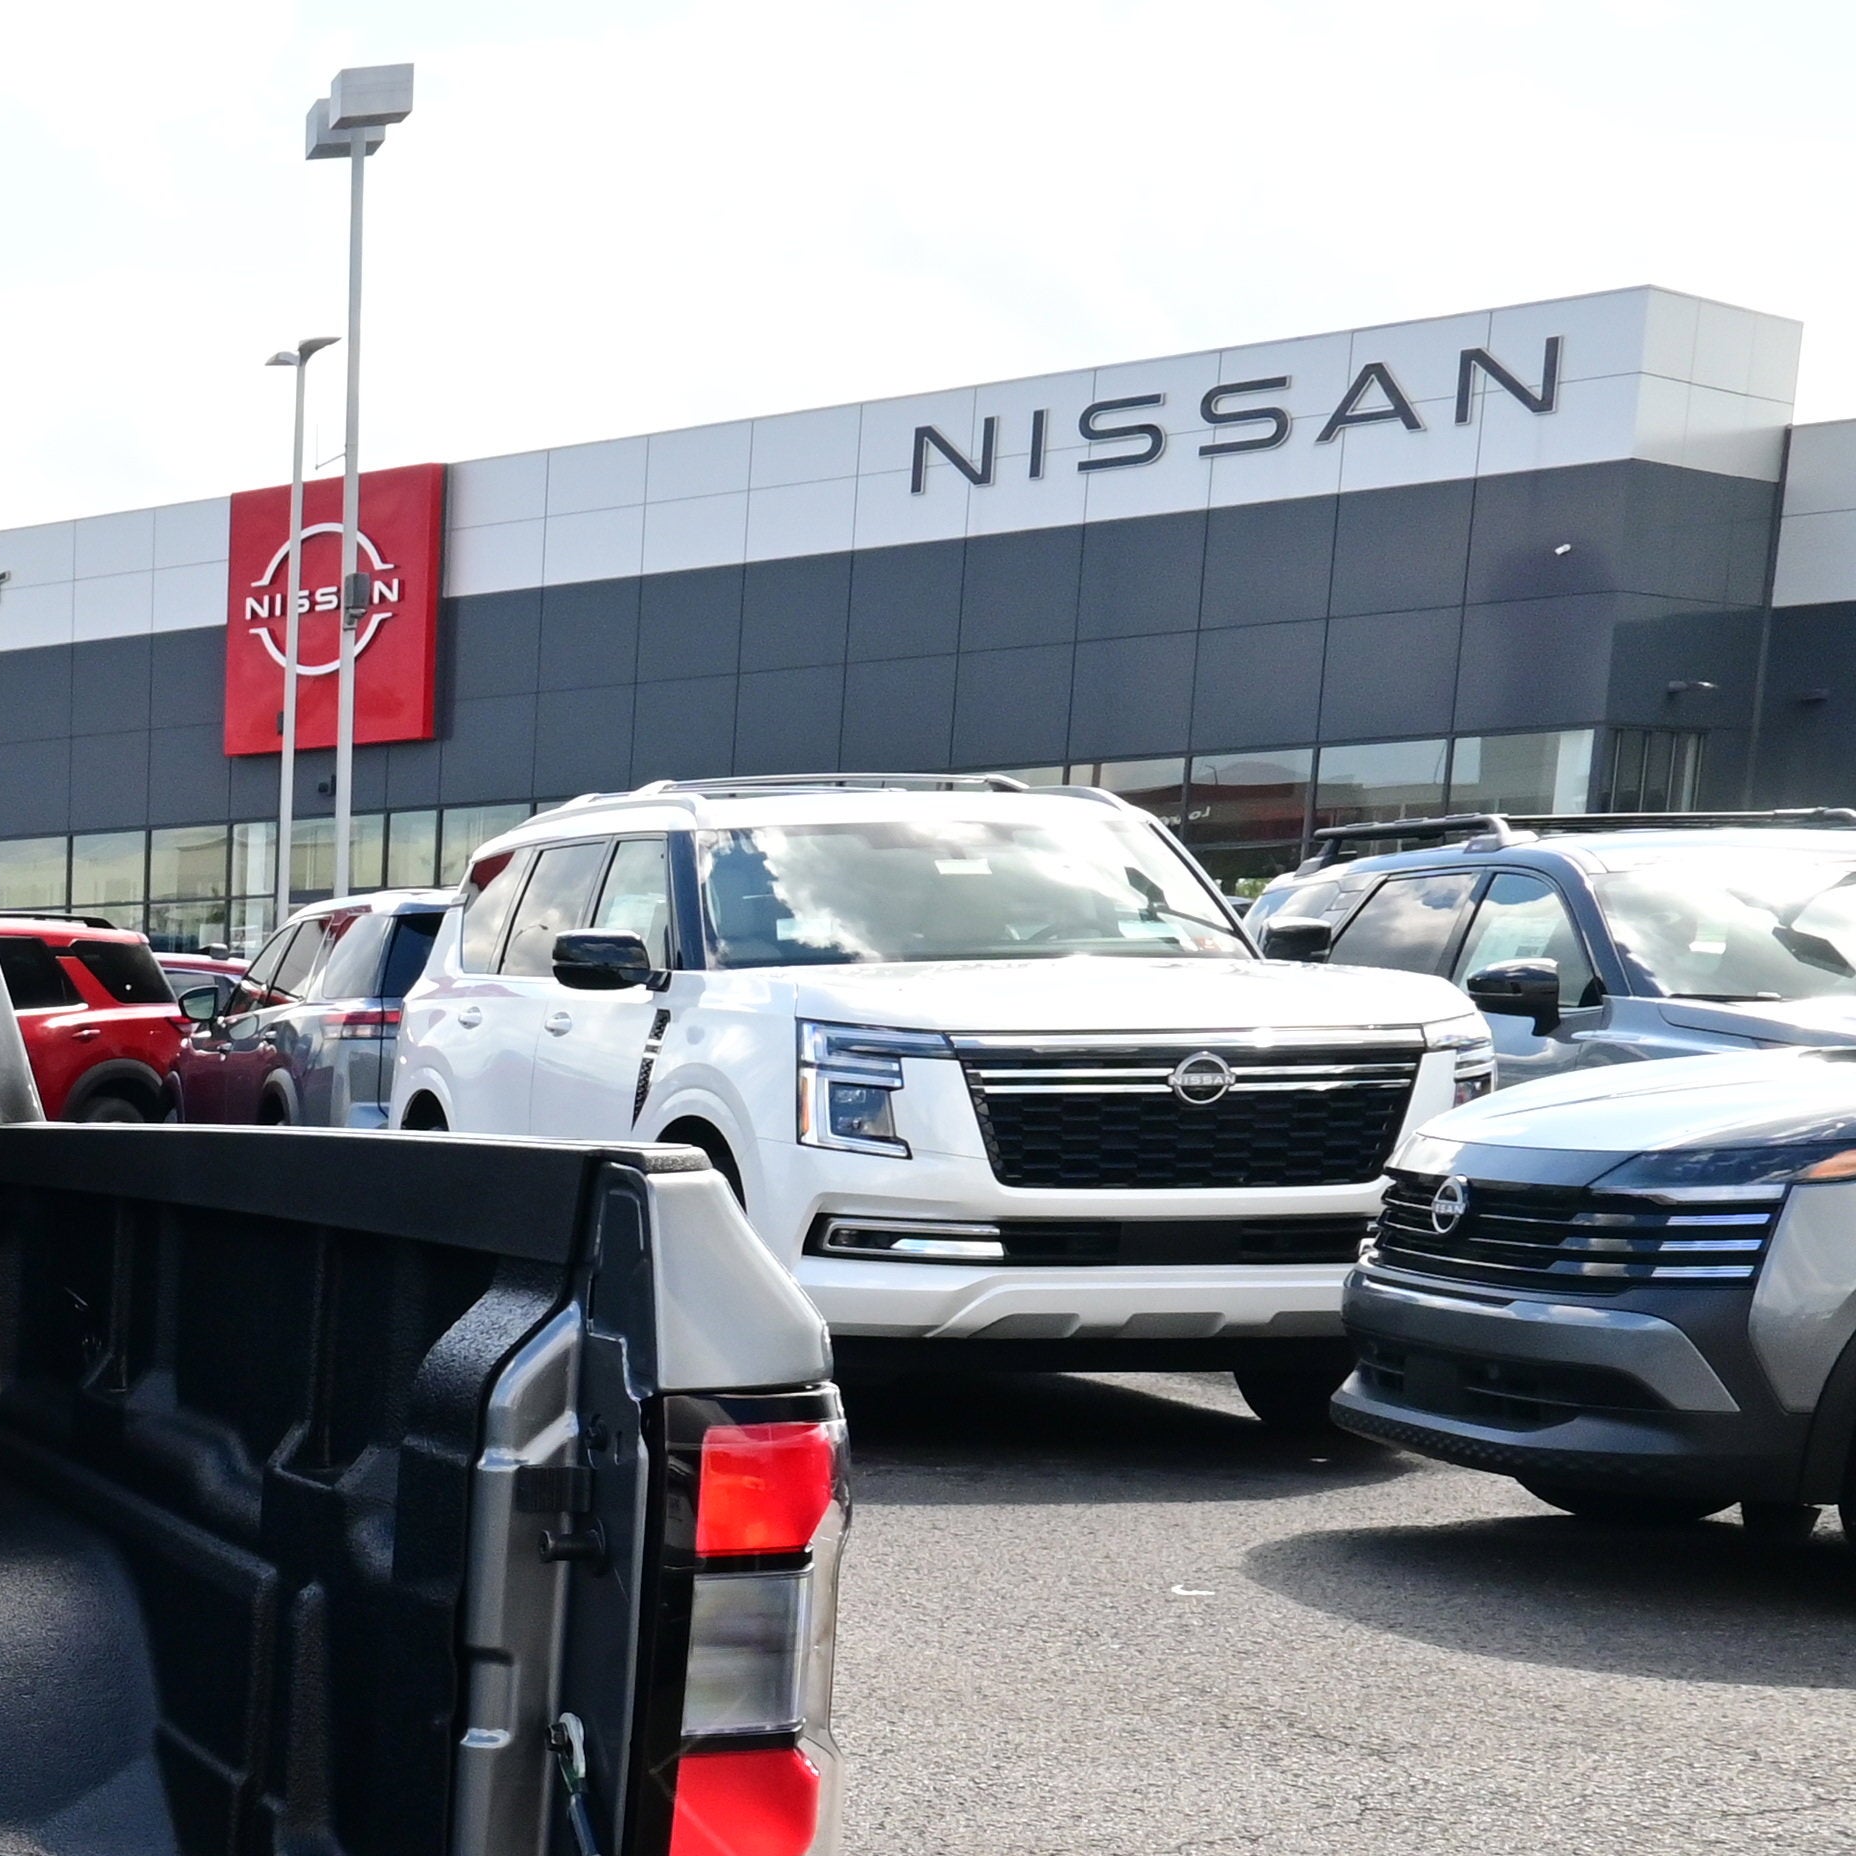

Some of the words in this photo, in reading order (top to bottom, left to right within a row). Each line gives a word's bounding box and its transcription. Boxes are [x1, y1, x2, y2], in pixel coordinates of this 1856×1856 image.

[910, 335, 1563, 496] NISSAN
[245, 578, 399, 620] NISSN
[1169, 1074, 1236, 1086] NISSAN
